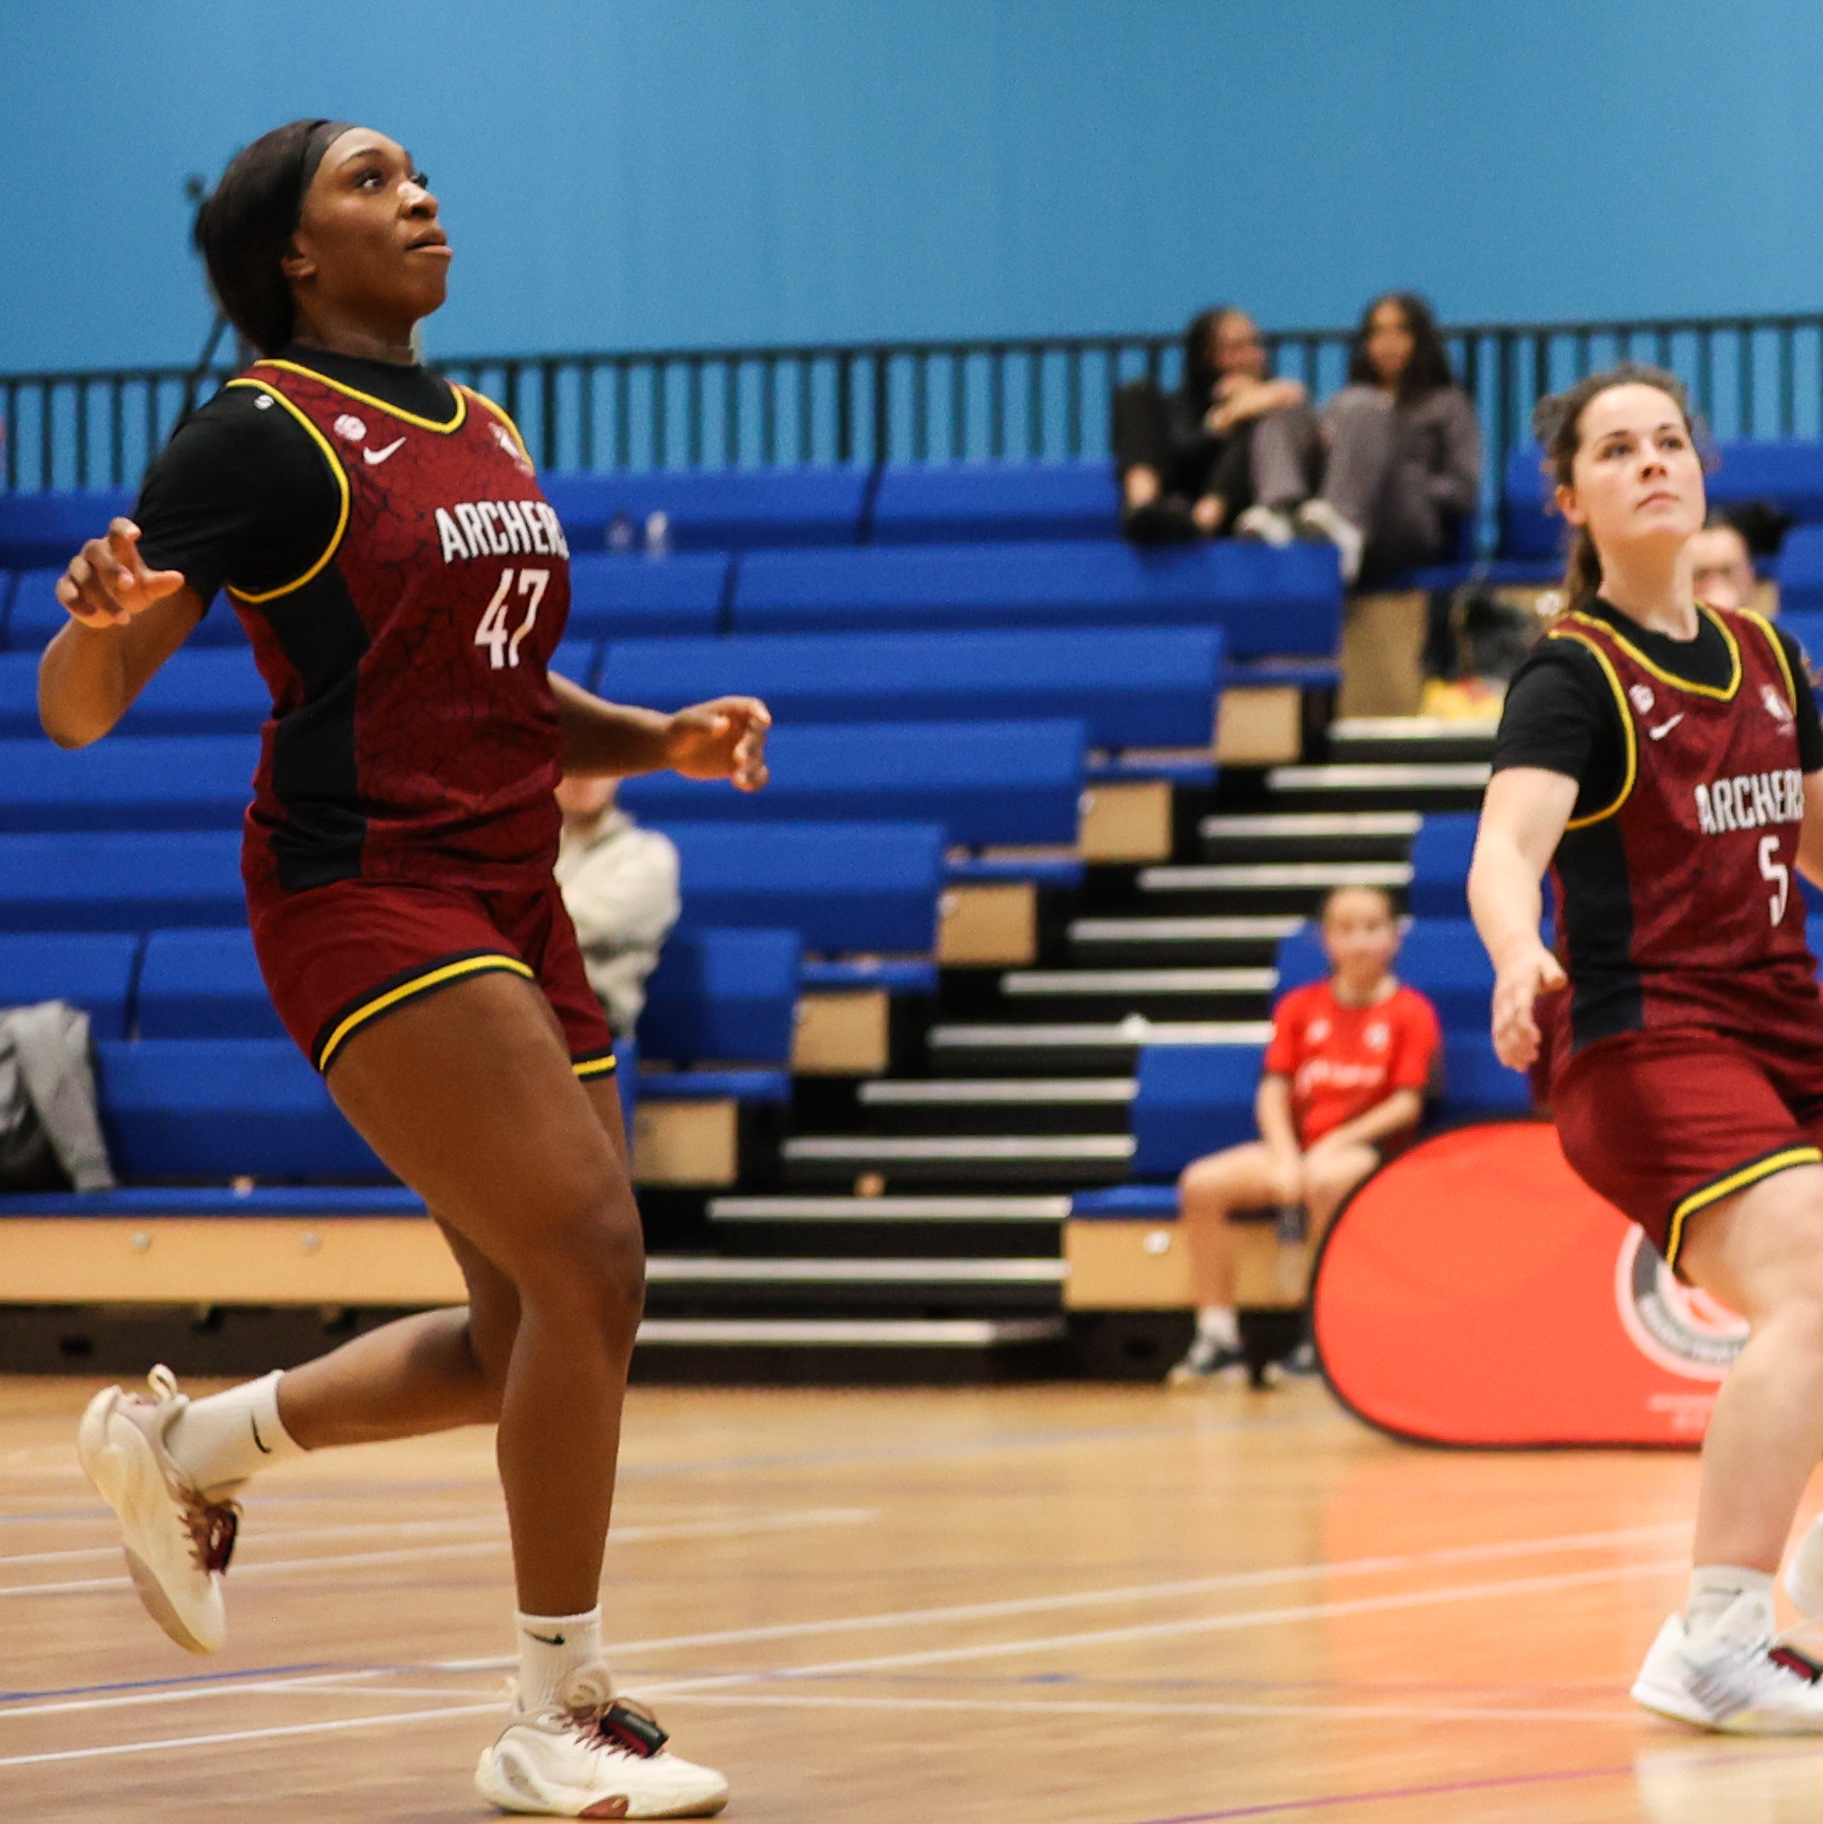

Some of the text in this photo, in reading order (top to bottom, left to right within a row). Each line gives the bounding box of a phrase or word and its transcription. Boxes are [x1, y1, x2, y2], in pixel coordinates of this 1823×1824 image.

[434, 500, 570, 563] ARCHER
[475, 568, 550, 668] 47
[1695, 769, 1804, 834] ARCHER
[1758, 835, 1788, 927] 5
